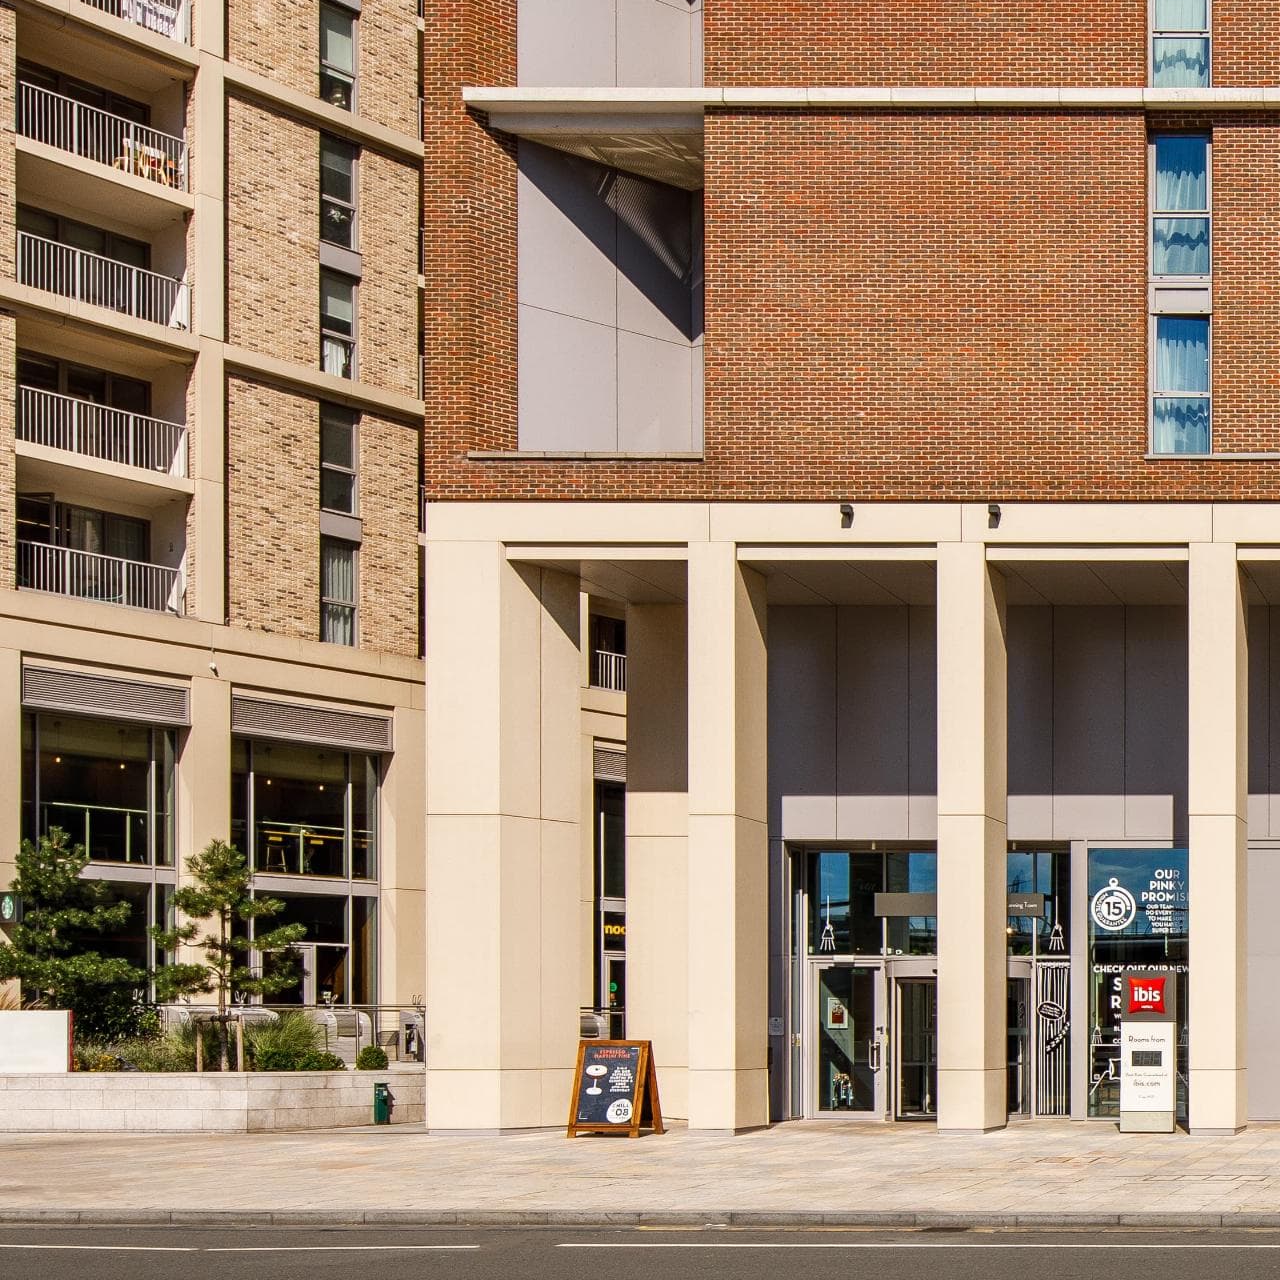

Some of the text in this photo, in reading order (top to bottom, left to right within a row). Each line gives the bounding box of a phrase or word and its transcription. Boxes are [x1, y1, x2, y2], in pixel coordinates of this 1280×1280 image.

[1154, 869, 1180, 880] OUR
[1149, 880, 1185, 891] PINKY
[1141, 892, 1189, 902] PROMIS
[1105, 901, 1123, 916] 15
[1093, 964, 1125, 973] CHECK
[1133, 987, 1161, 1002] ibis
[1128, 1035, 1150, 1043] Rooms
